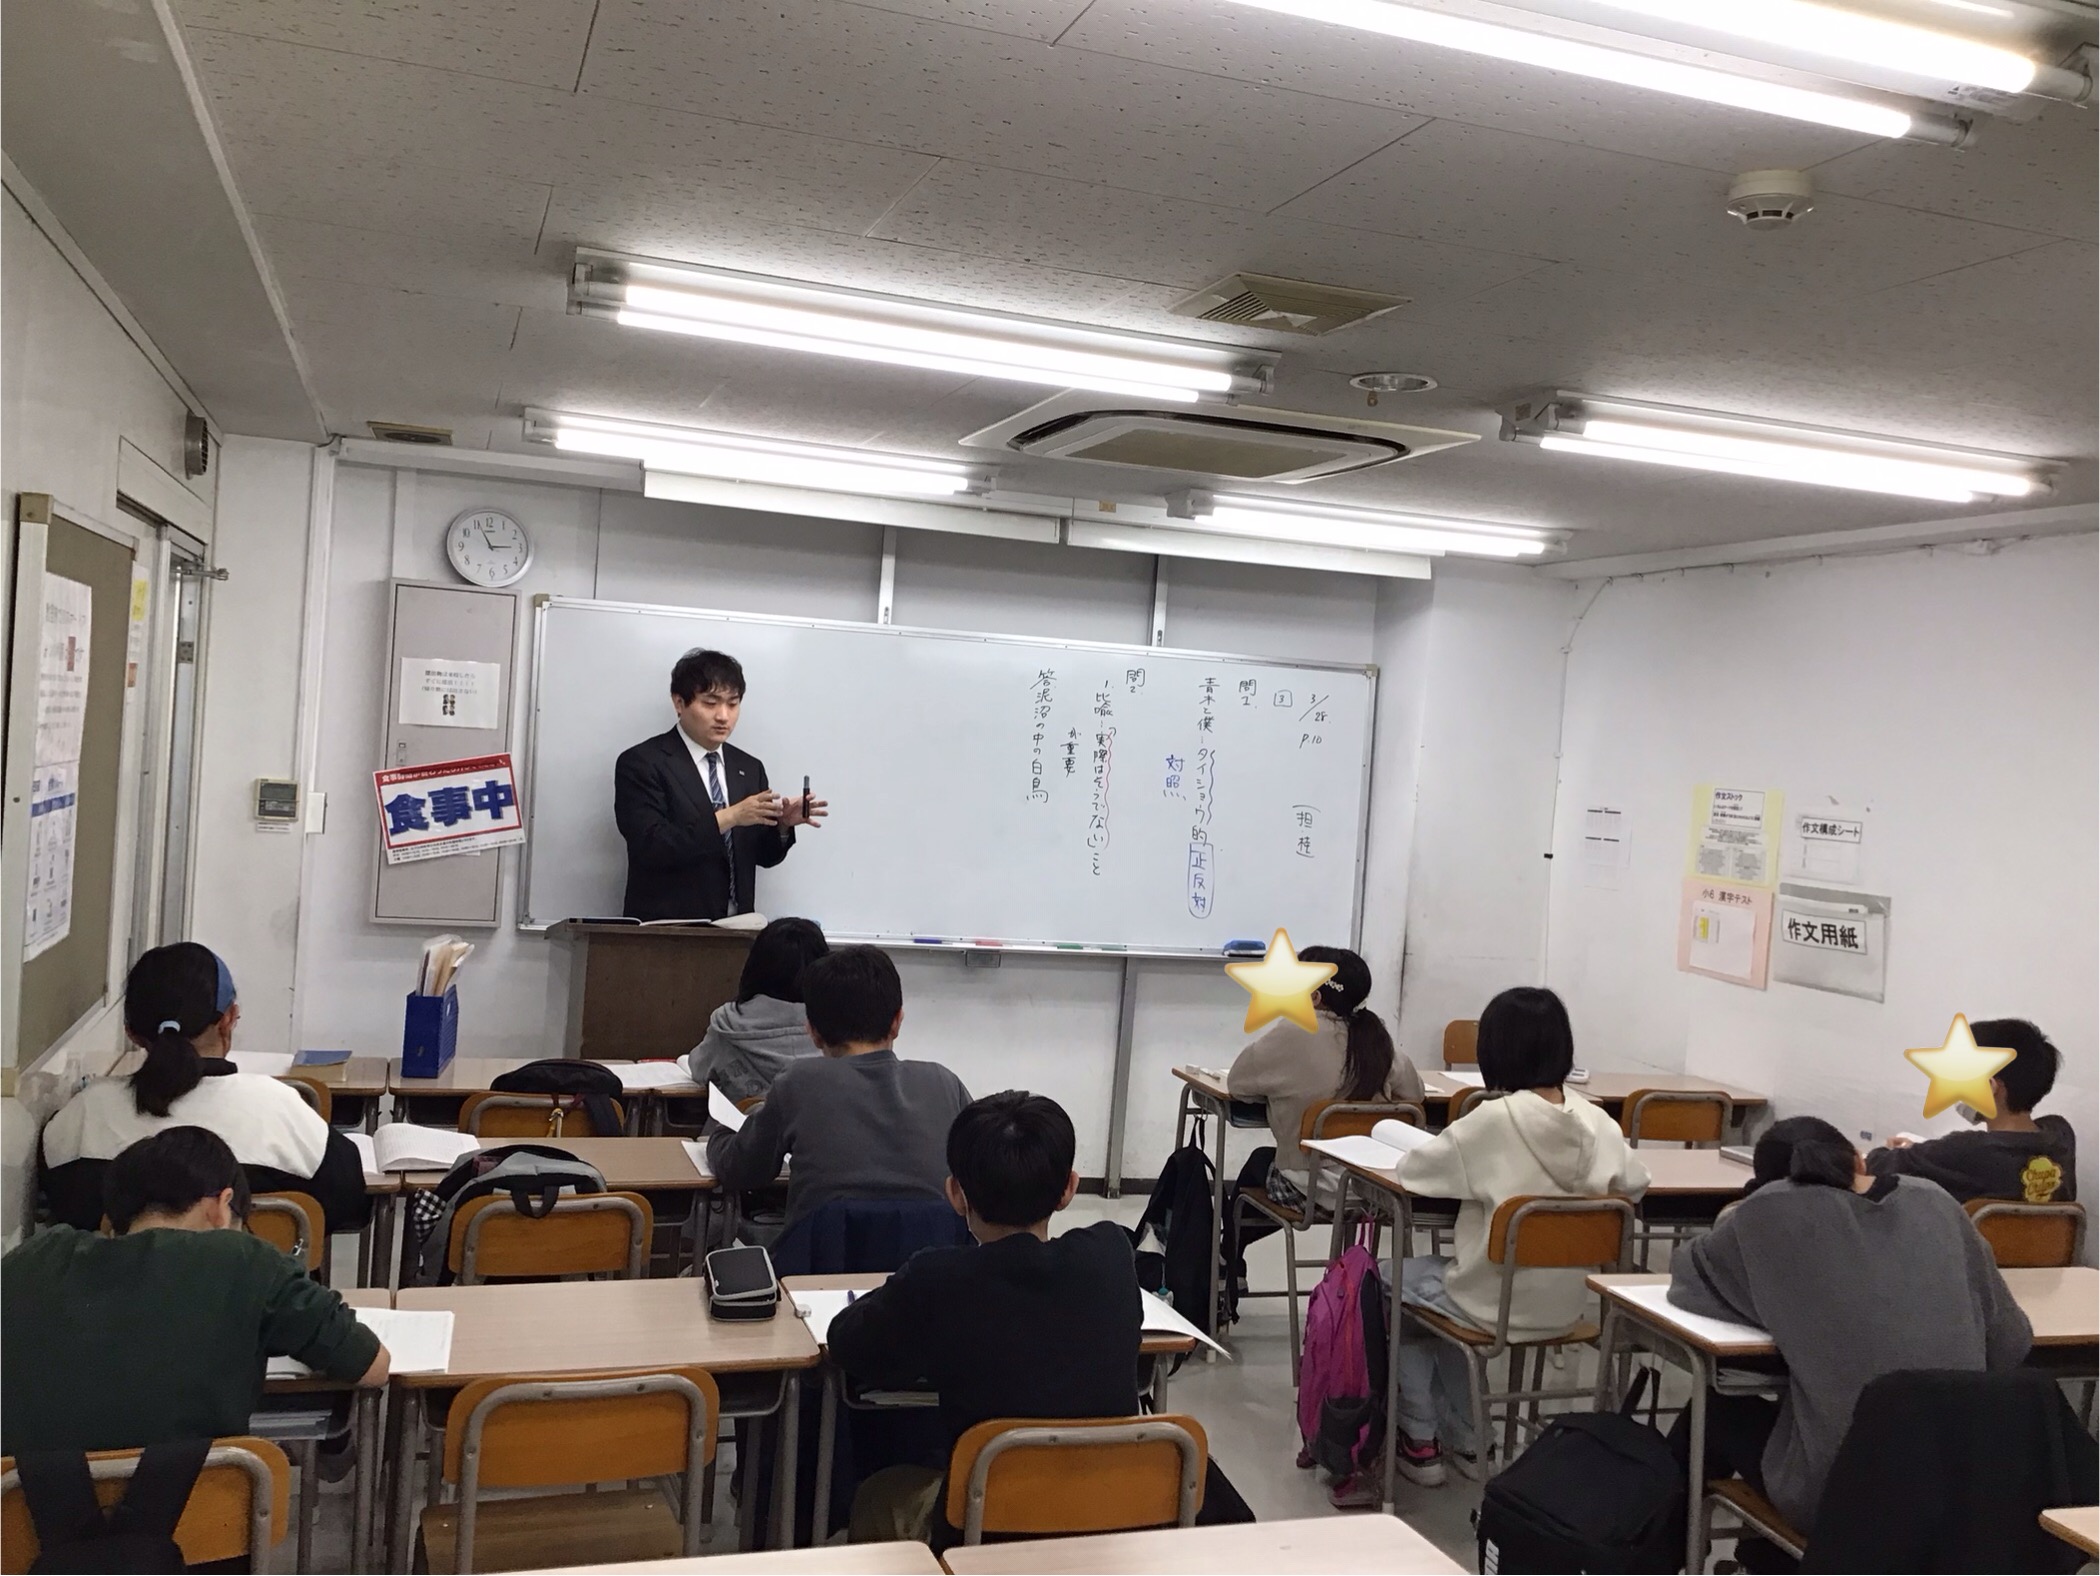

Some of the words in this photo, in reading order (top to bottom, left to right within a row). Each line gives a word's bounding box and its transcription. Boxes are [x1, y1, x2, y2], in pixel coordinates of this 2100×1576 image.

[485, 516, 494, 528] 12
[462, 527, 471, 538] 10
[511, 529, 517, 540] 2
[458, 541, 464, 551] 9
[464, 554, 470, 565] 8
[513, 556, 518, 566] 4
[476, 563, 482, 574] 7
[488, 566, 495, 580] 6
[503, 564, 508, 575] 5
[1163, 754, 1187, 801] 対照
[1715, 792, 1743, 801] 作文ストック
[384, 780, 516, 836] 食事中
[1802, 822, 1860, 838] 作文構成シート
[1702, 889, 1715, 899] 小6
[1719, 891, 1753, 905] 漢字テスト
[1787, 917, 1859, 949] 作文用紙
